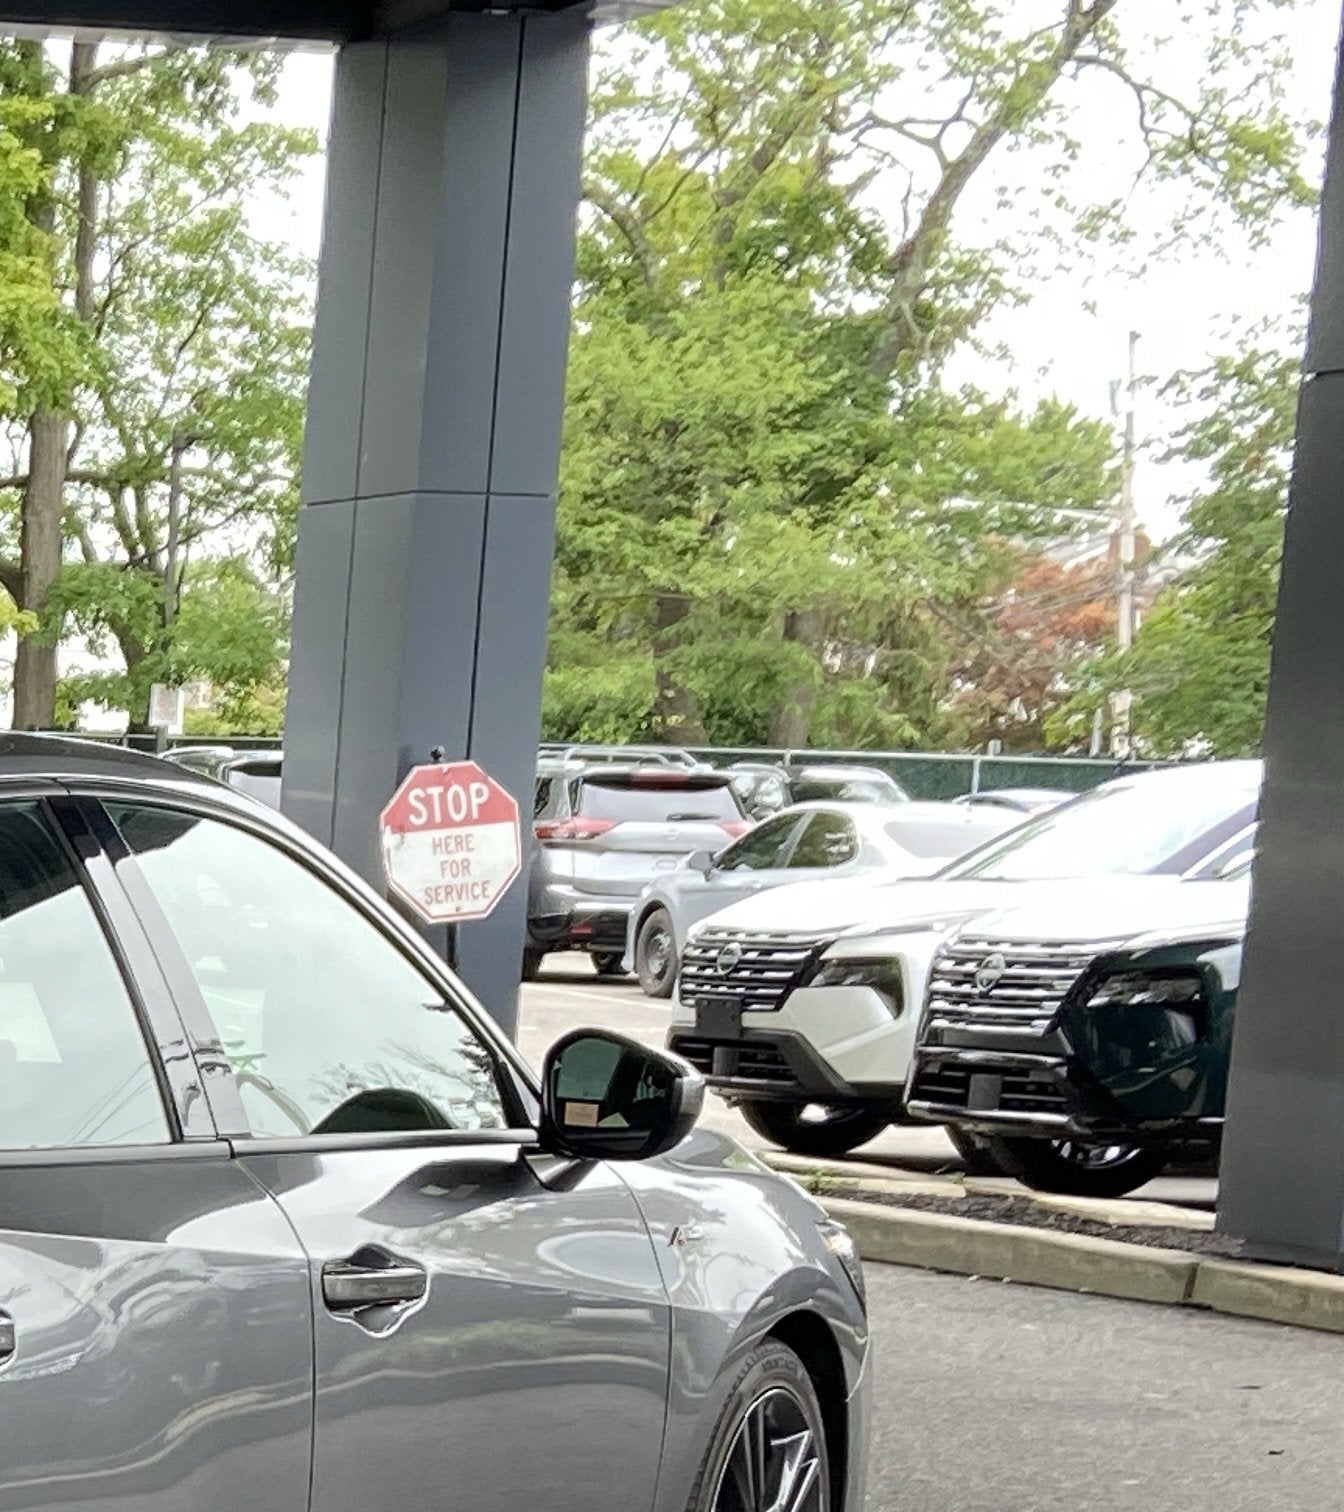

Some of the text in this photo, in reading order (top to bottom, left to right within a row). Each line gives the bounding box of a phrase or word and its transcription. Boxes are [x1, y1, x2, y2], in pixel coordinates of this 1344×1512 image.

[408, 782, 489, 826] STOP
[432, 833, 475, 855] HERE
[440, 858, 471, 879] FOR
[424, 880, 491, 905] SERVICE
